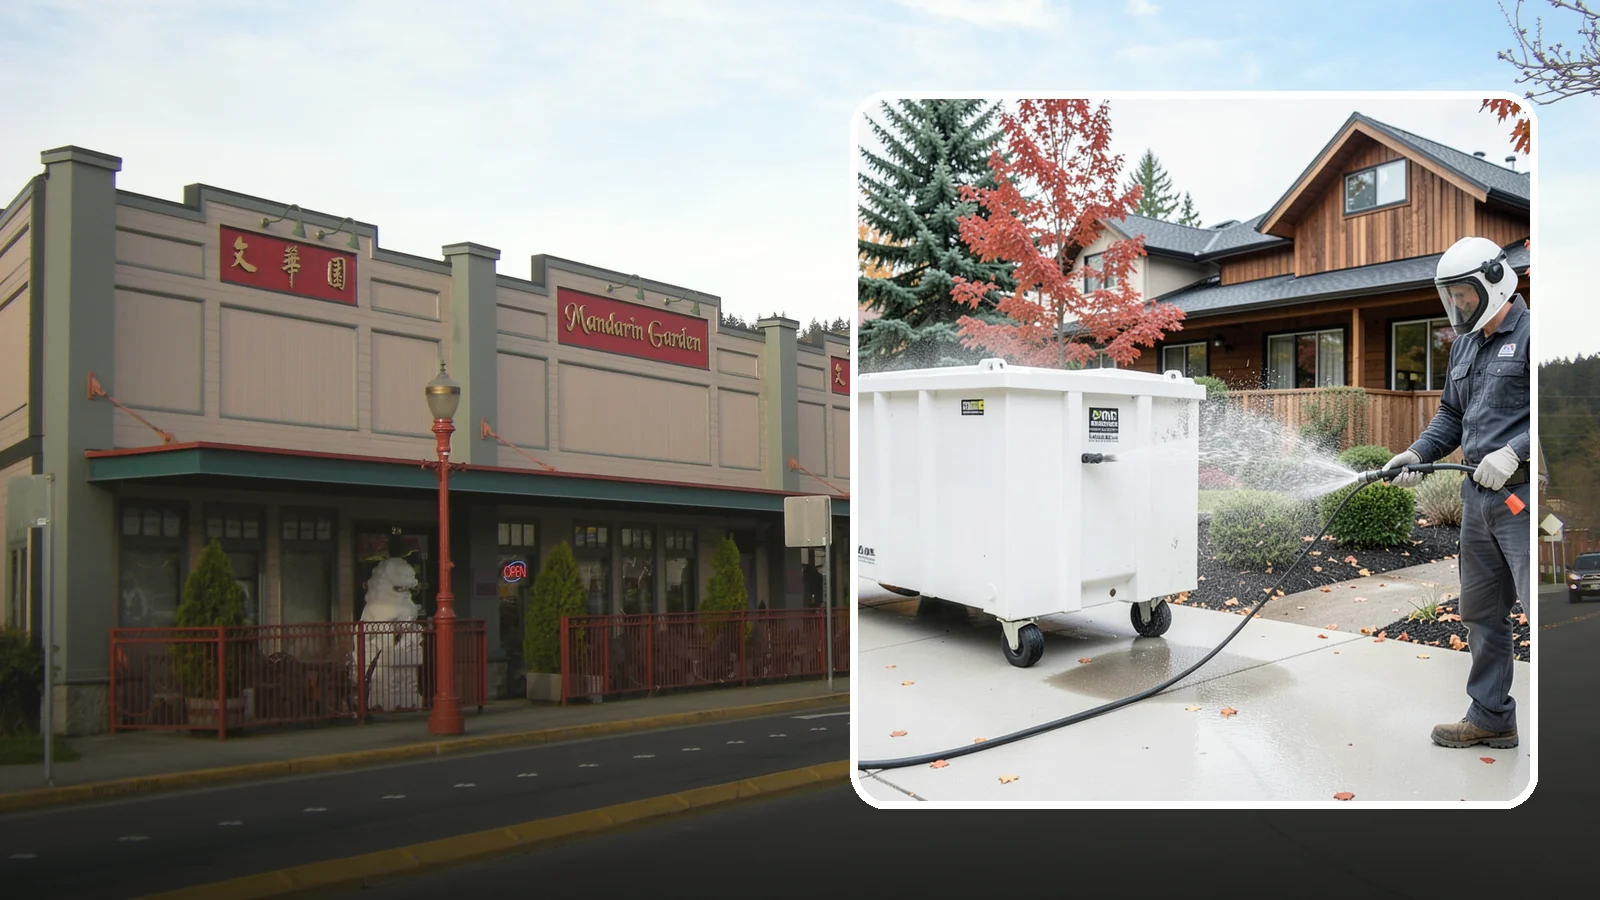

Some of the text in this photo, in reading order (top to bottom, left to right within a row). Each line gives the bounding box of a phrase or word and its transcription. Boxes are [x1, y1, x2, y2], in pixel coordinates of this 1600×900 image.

[231, 236, 346, 291] 文華園
[564, 302, 702, 352] Mandarin Garden
[835, 363, 847, 386] 文
[503, 565, 527, 578] OPEN
